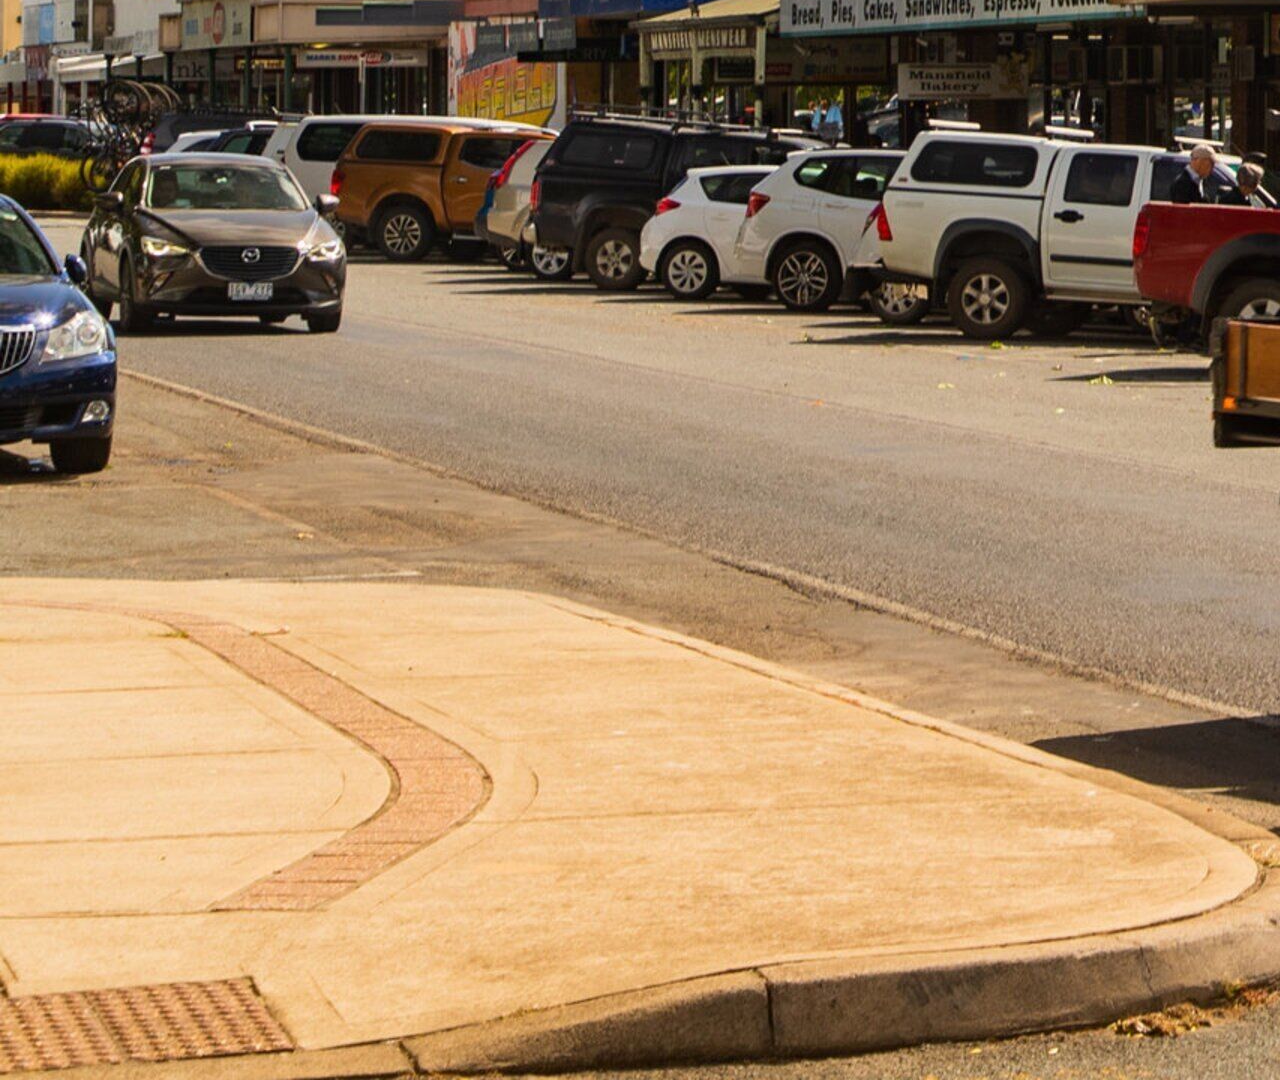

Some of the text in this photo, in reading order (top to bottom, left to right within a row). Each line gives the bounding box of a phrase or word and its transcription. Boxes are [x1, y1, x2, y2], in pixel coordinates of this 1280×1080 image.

[791, 2, 825, 28] Bread,
[831, 0, 856, 27] Pies,
[909, 70, 991, 81] Mansfield
